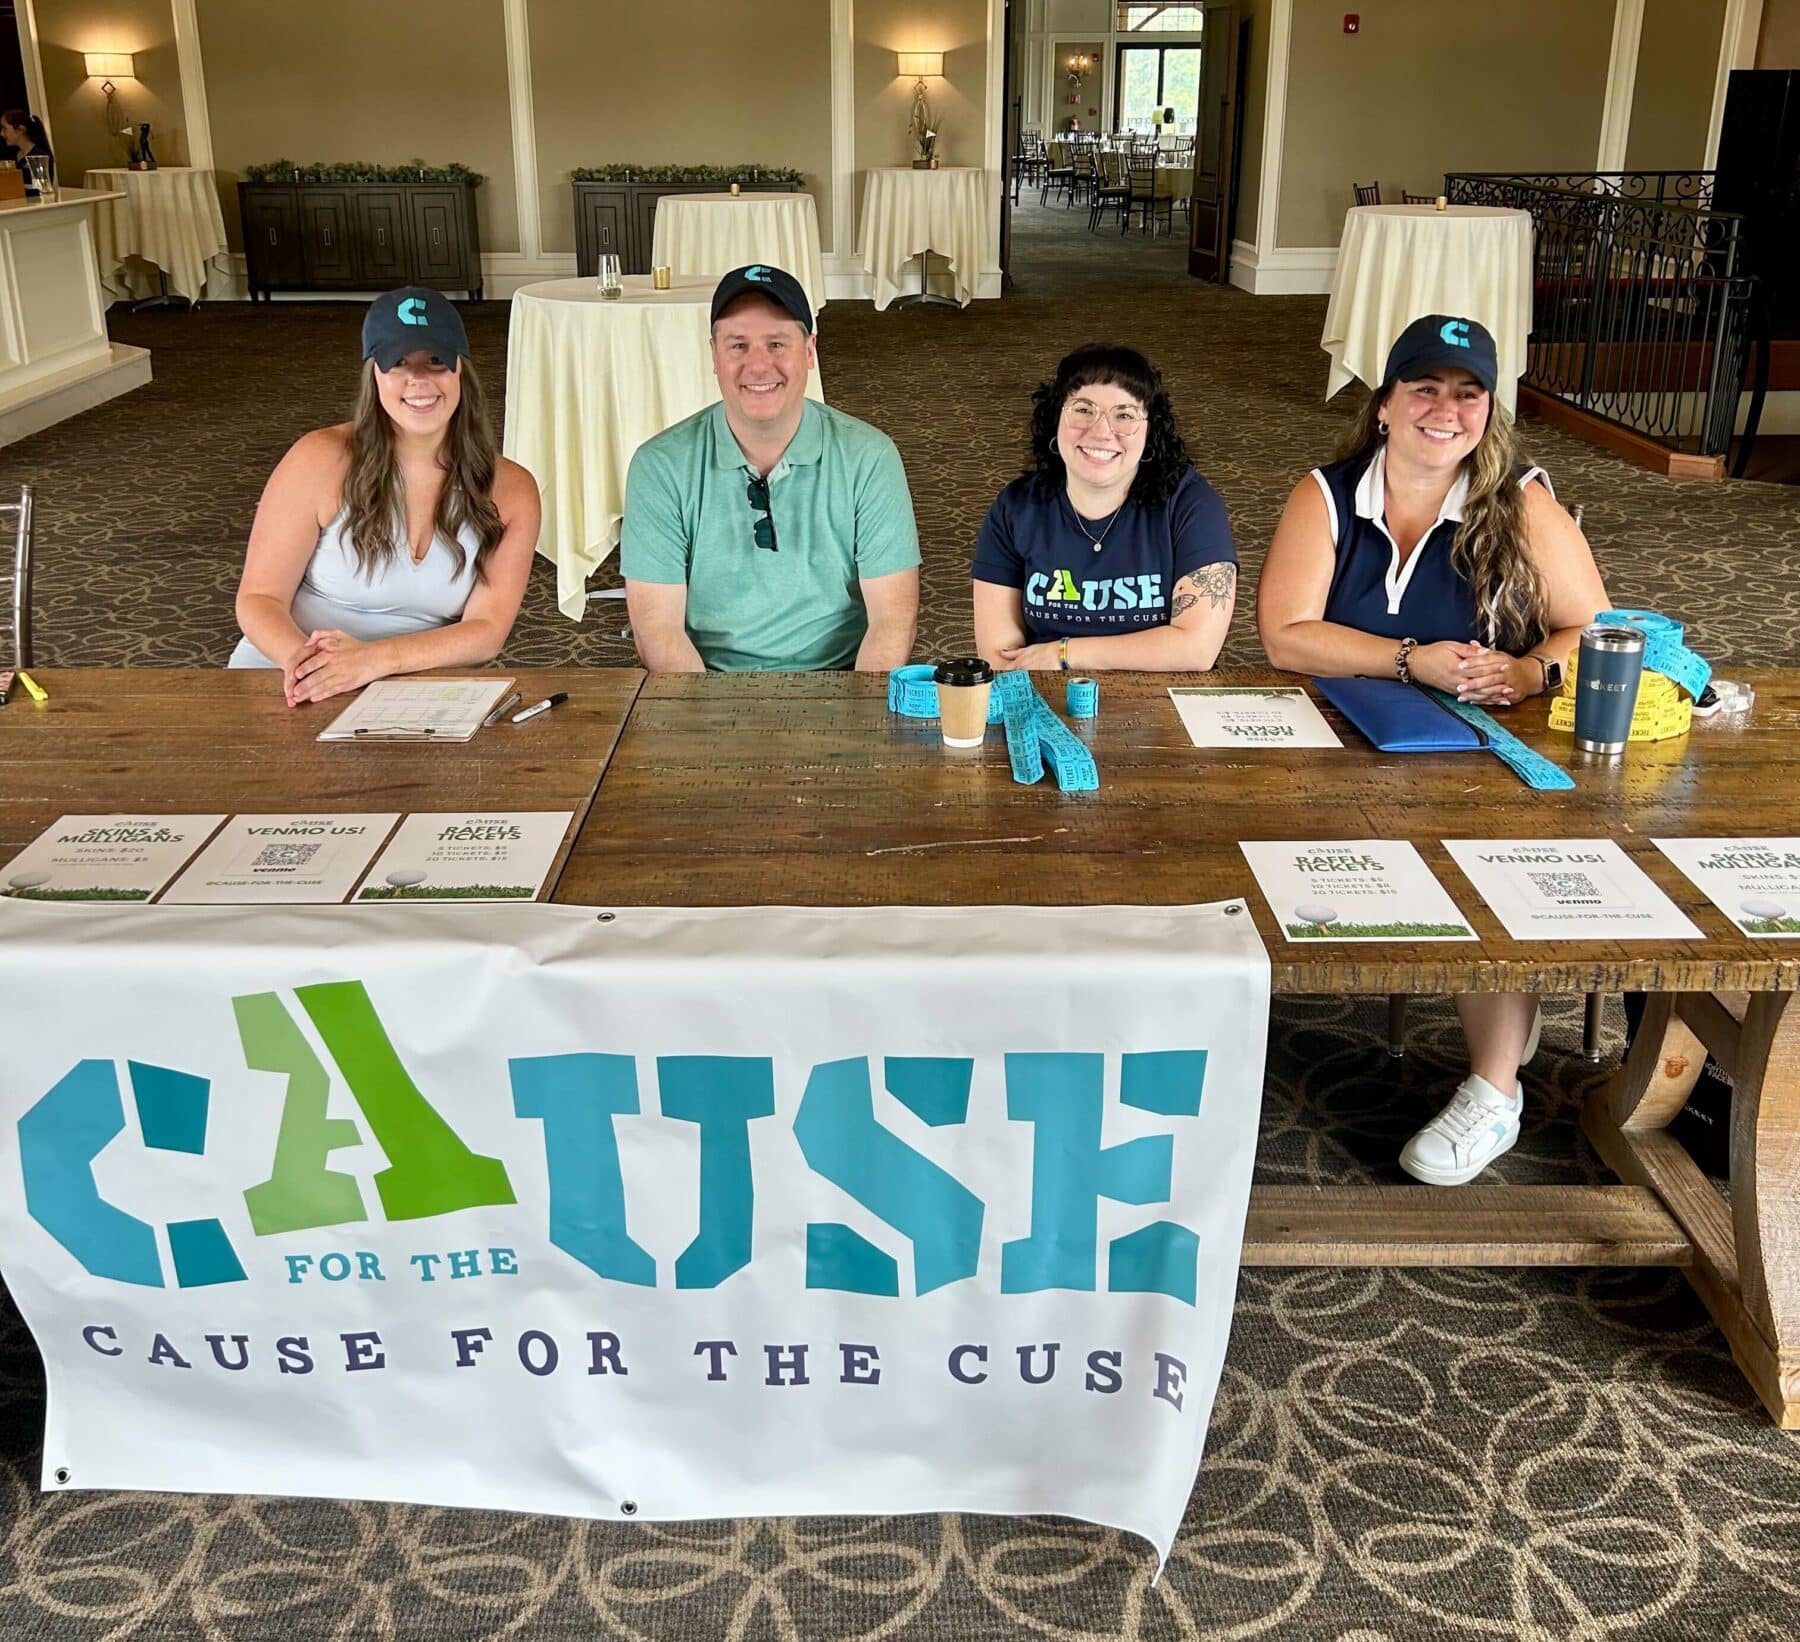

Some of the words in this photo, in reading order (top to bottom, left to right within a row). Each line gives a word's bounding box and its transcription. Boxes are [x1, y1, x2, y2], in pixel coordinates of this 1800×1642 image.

[398, 297, 429, 326] C
[1440, 321, 1470, 348] C
[1026, 569, 1165, 611] CAUSE
[1024, 607, 1059, 620] CAUSE
[1133, 613, 1168, 622] CUSE
[1073, 690, 1092, 698] TICKET
[1556, 719, 1575, 728] ICKET
[1065, 765, 1075, 786] TICKET
[87, 828, 150, 836] SKINS
[248, 827, 325, 835] VENMO
[330, 827, 367, 835] US!
[445, 825, 520, 834] RAFFLE
[57, 834, 185, 843] MULLIGANS
[437, 832, 522, 841] TICKETS
[1295, 855, 1375, 865] RAFFLE
[1478, 855, 1563, 863] VENMO
[1567, 855, 1606, 863] US!
[1710, 852, 1780, 861] SKINS
[1784, 853, 1800, 861] &
[1293, 863, 1385, 872] TICKETS
[1698, 860, 1800, 869] MULLIGA
[17, 980, 1209, 1306] CAUSE
[286, 1250, 386, 1285] FOR
[409, 1248, 519, 1282] THE
[82, 1325, 385, 1375] CAUSE
[451, 1327, 628, 1376] FOR
[693, 1341, 881, 1386] THE
[948, 1343, 1187, 1411] CUSE
